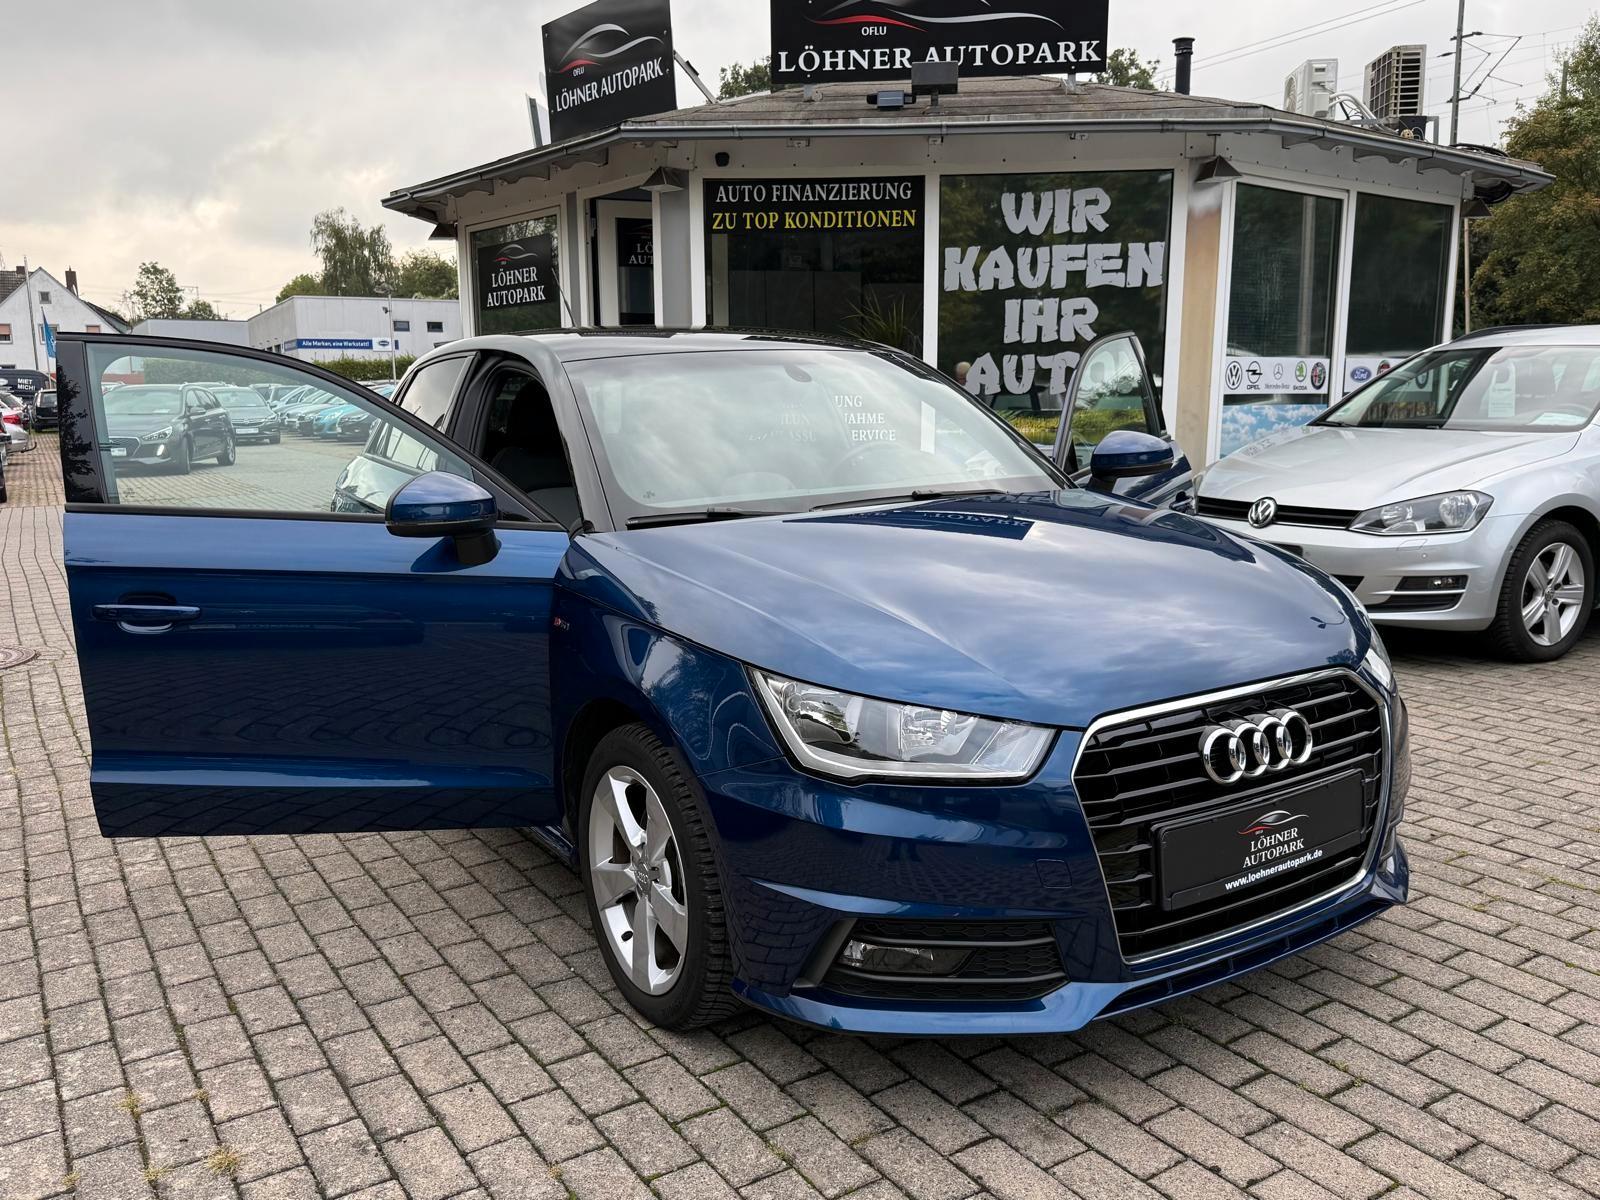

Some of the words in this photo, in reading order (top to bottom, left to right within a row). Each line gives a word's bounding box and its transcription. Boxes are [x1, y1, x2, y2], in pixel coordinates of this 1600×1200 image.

[861, 26, 887, 36] OFLU
[778, 45, 912, 73] LÖHNER
[924, 40, 1101, 68] AUTOPARK
[555, 81, 600, 112] LÖHNER
[600, 56, 664, 97] AUTOPARK
[572, 66, 585, 77] OFLU
[716, 185, 766, 203] AUTO
[771, 182, 912, 202] FINANZIERUNG
[712, 212, 737, 230] ZU
[743, 211, 779, 230] TOP
[784, 209, 917, 229] KONDITIONEN
[1001, 187, 1111, 236] WIR
[491, 266, 538, 288] LÖHNER
[943, 241, 1166, 292] KAUFEN
[487, 285, 546, 308] AUTOPARK
[1003, 297, 1099, 344] IHR
[851, 429, 897, 441] ERVICE
[1250, 827, 1298, 852] LÖHNER
[1242, 838, 1305, 869] AUTOPARK
[1224, 849, 1323, 891] www.loehnerautopark.de
